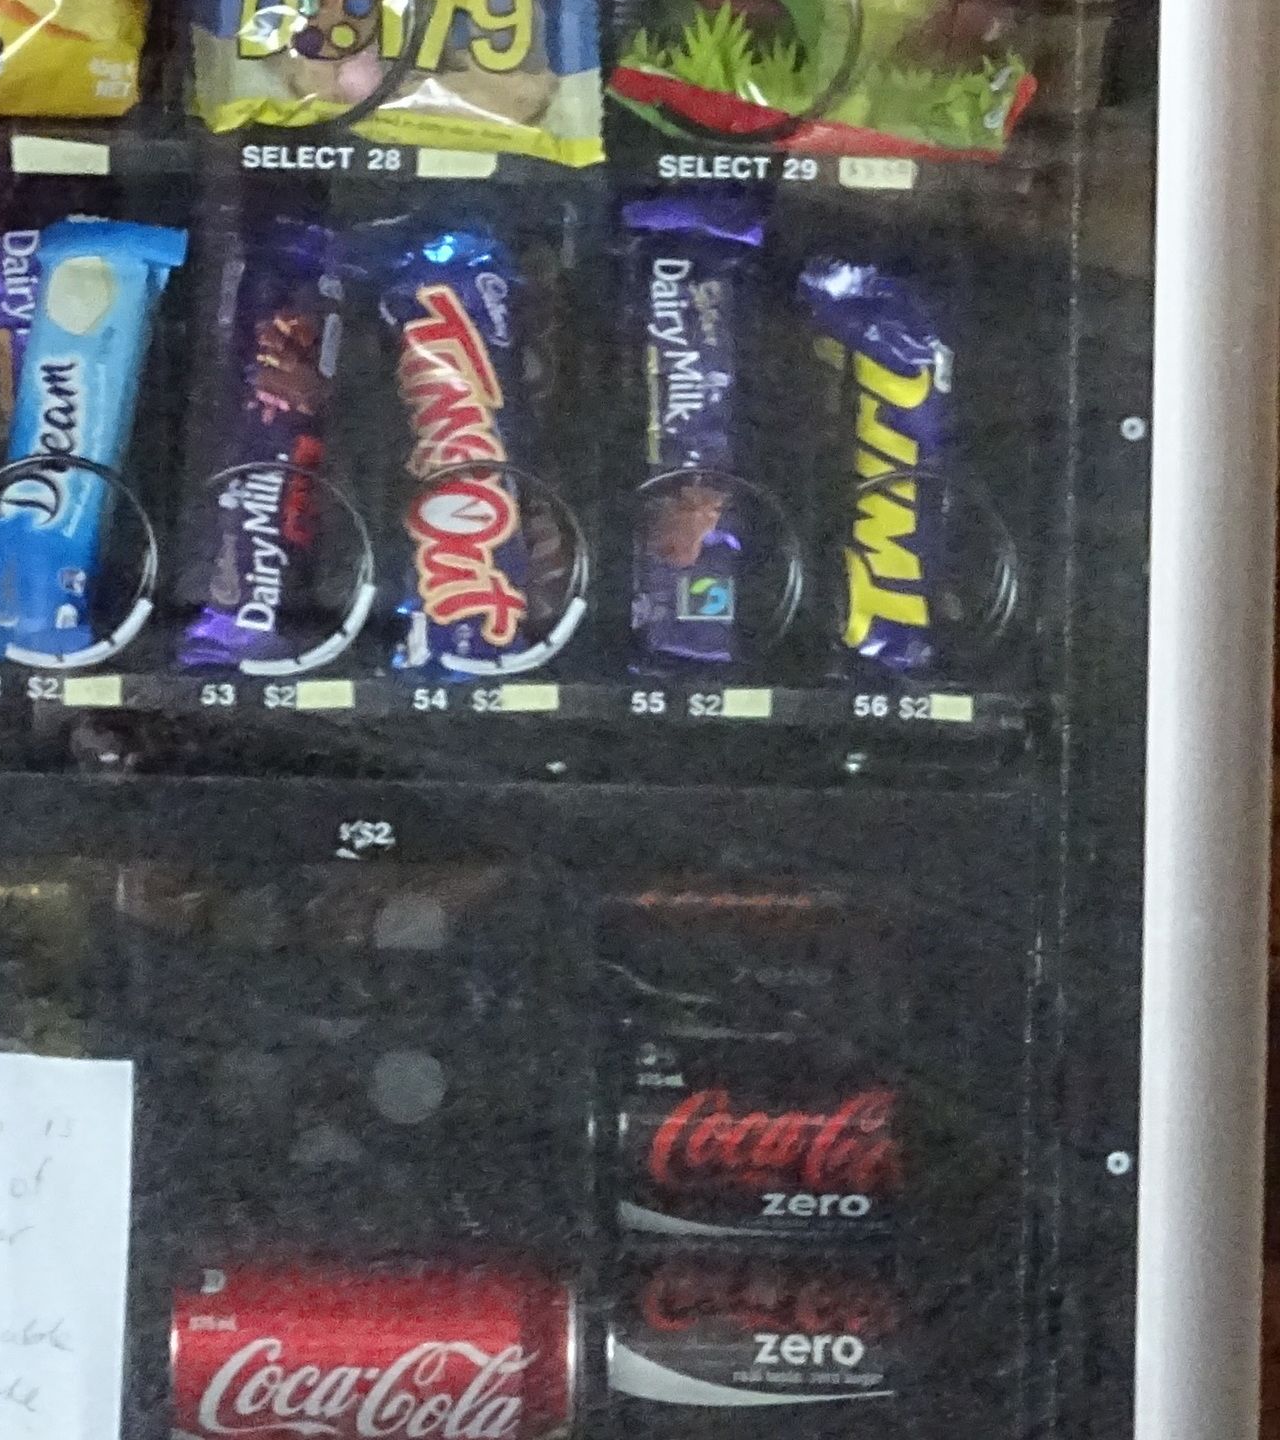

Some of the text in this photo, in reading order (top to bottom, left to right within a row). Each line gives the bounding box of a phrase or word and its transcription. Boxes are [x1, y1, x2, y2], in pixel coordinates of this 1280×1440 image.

[242, 147, 401, 171] SELECT 28
[658, 155, 772, 180] SELECT
[781, 158, 818, 181] 29
[0, 228, 40, 333] Dairy
[647, 257, 705, 426] Dairy Milk
[236, 534, 289, 632] Dairy
[200, 683, 235, 705] 53
[412, 688, 448, 710] 54
[631, 691, 665, 713] 55
[854, 694, 888, 717] 56
[760, 1192, 872, 1217] zero
[752, 1332, 865, 1368] zero
[197, 1337, 541, 1440] Coca-Cola
